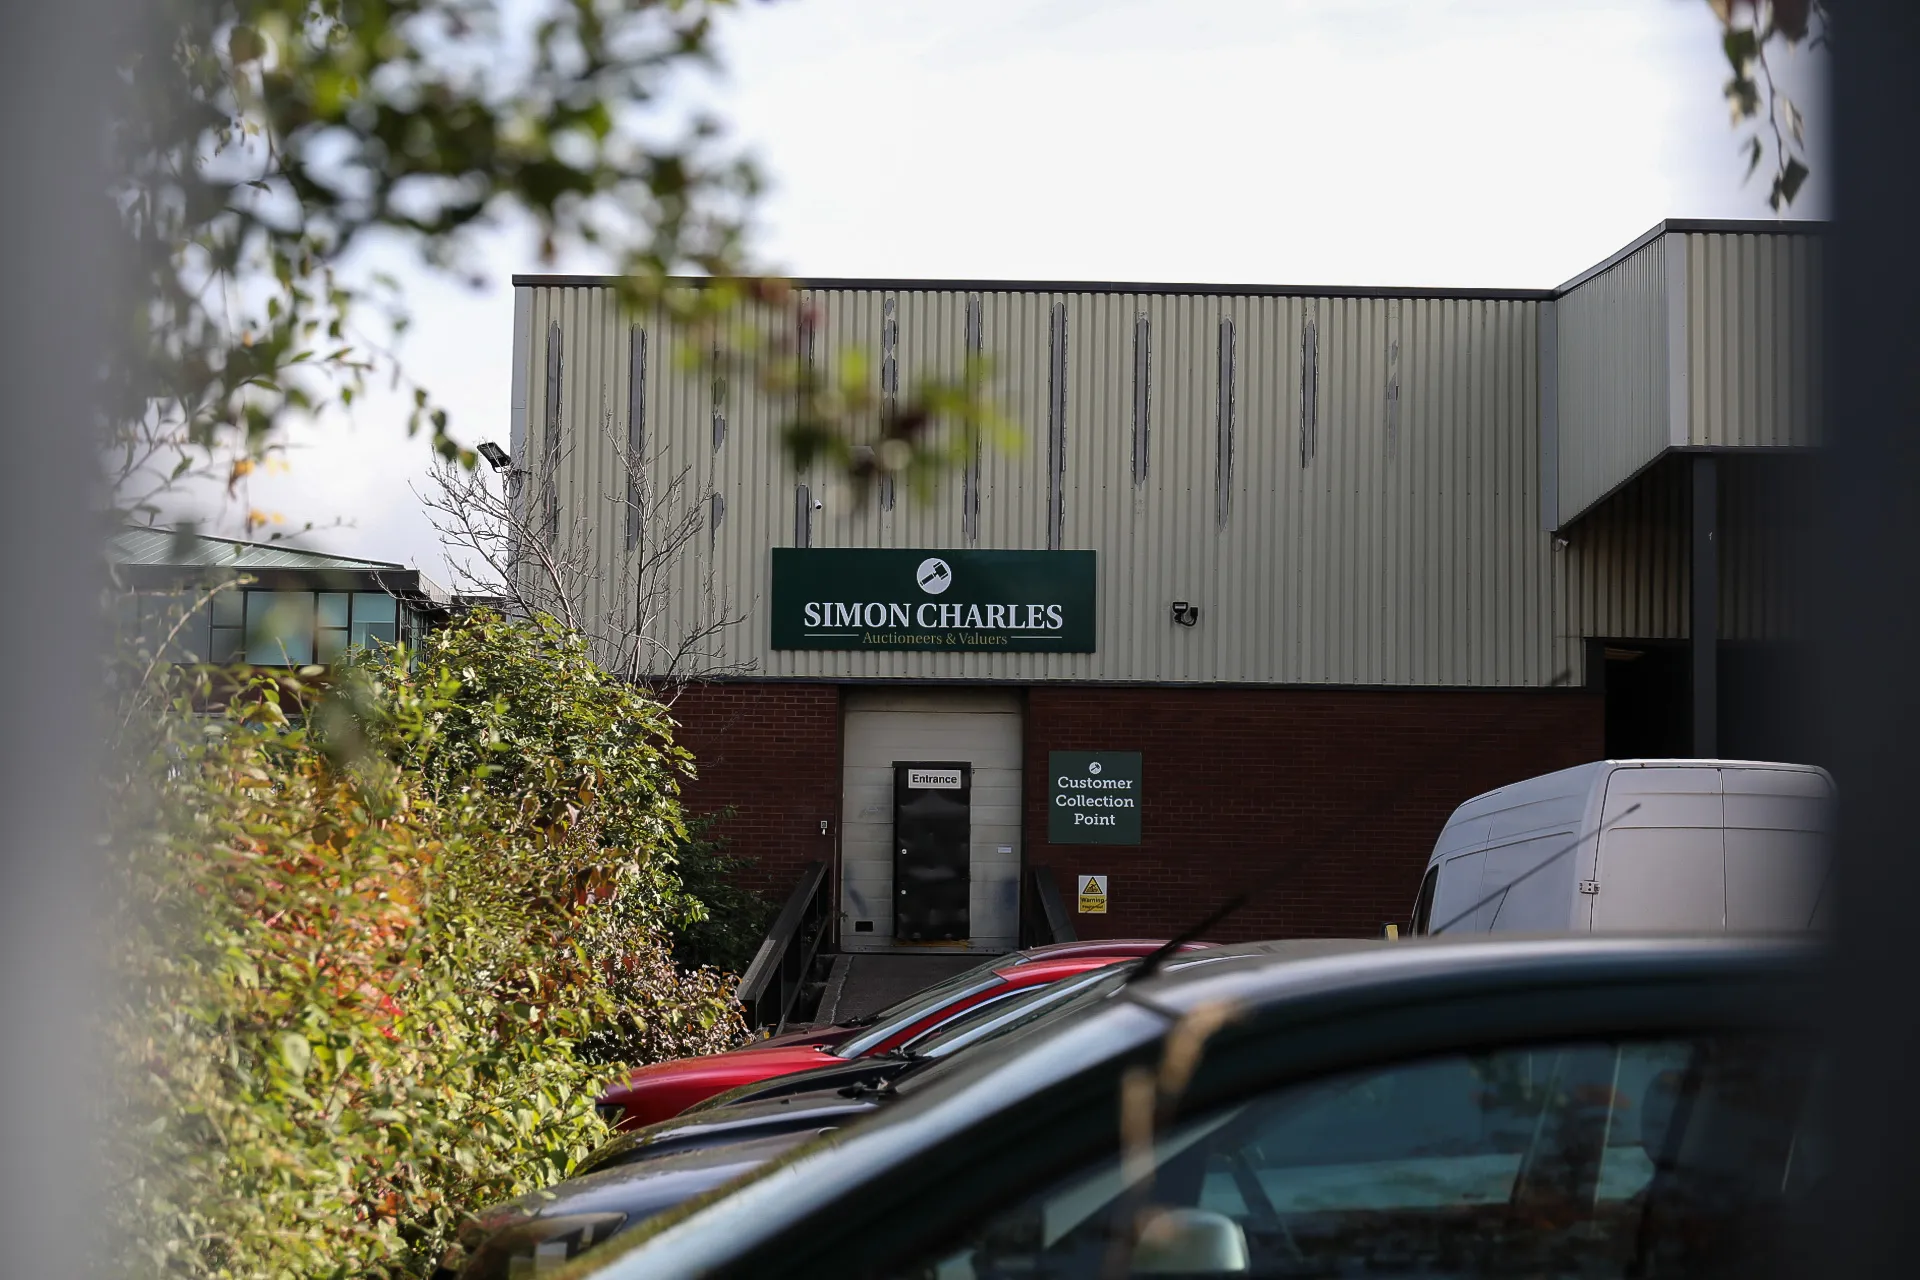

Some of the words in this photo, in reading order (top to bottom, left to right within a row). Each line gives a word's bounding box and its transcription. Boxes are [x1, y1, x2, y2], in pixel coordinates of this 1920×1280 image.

[804, 601, 911, 628] SIMON
[916, 603, 1063, 630] CHARLES
[862, 631, 943, 645] Auctioneers
[945, 633, 957, 645] &
[958, 632, 1008, 646] Valuers
[912, 773, 958, 784] Entrance
[1057, 776, 1133, 789] Customer
[1055, 794, 1135, 808] Collection
[1073, 812, 1116, 826] Point
